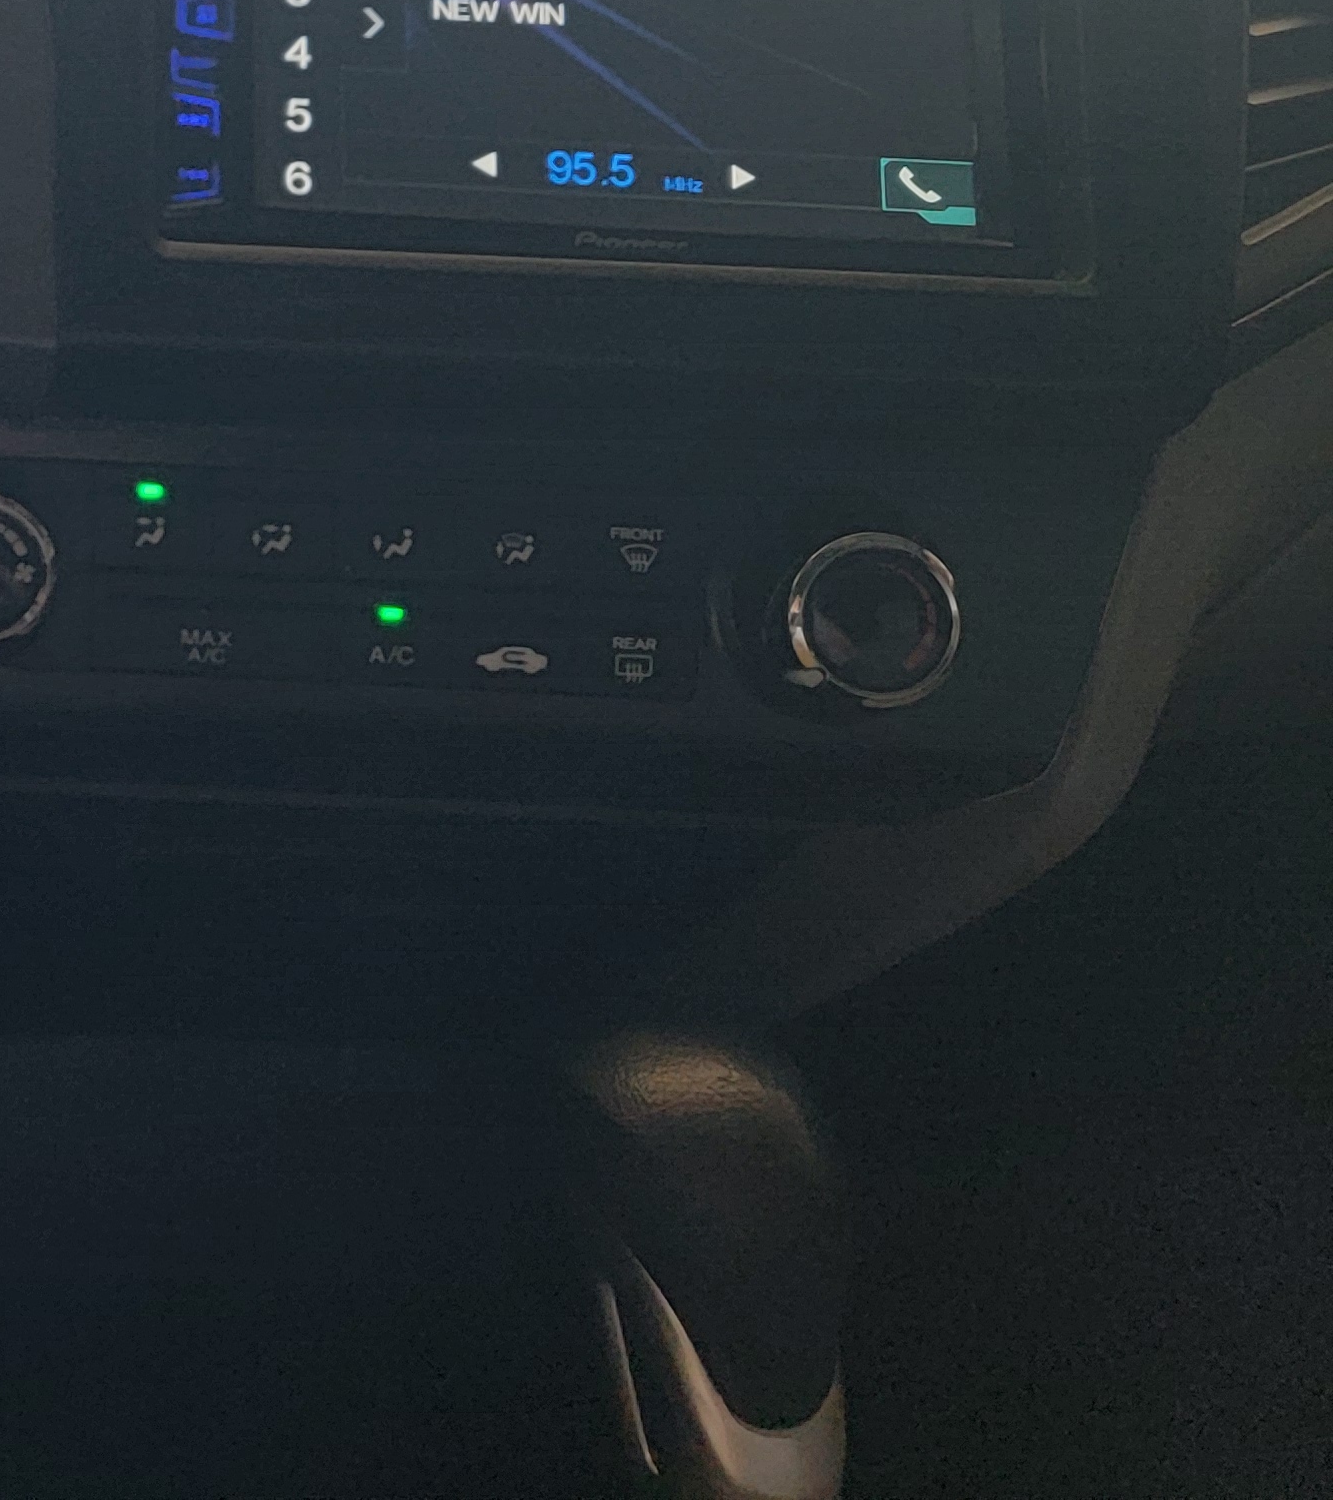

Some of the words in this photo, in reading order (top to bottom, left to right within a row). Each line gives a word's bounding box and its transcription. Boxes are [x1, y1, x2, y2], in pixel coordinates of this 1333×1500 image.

[510, 2, 565, 26] WIN
[283, 36, 312, 70] 4
[284, 98, 313, 133] 5
[284, 161, 313, 196] 6
[546, 149, 636, 188] 95.5
[610, 527, 664, 542] FRONT
[180, 629, 232, 647] MAX
[612, 637, 657, 651] REAR
[188, 646, 226, 665] A/C
[369, 646, 415, 665] A/C
